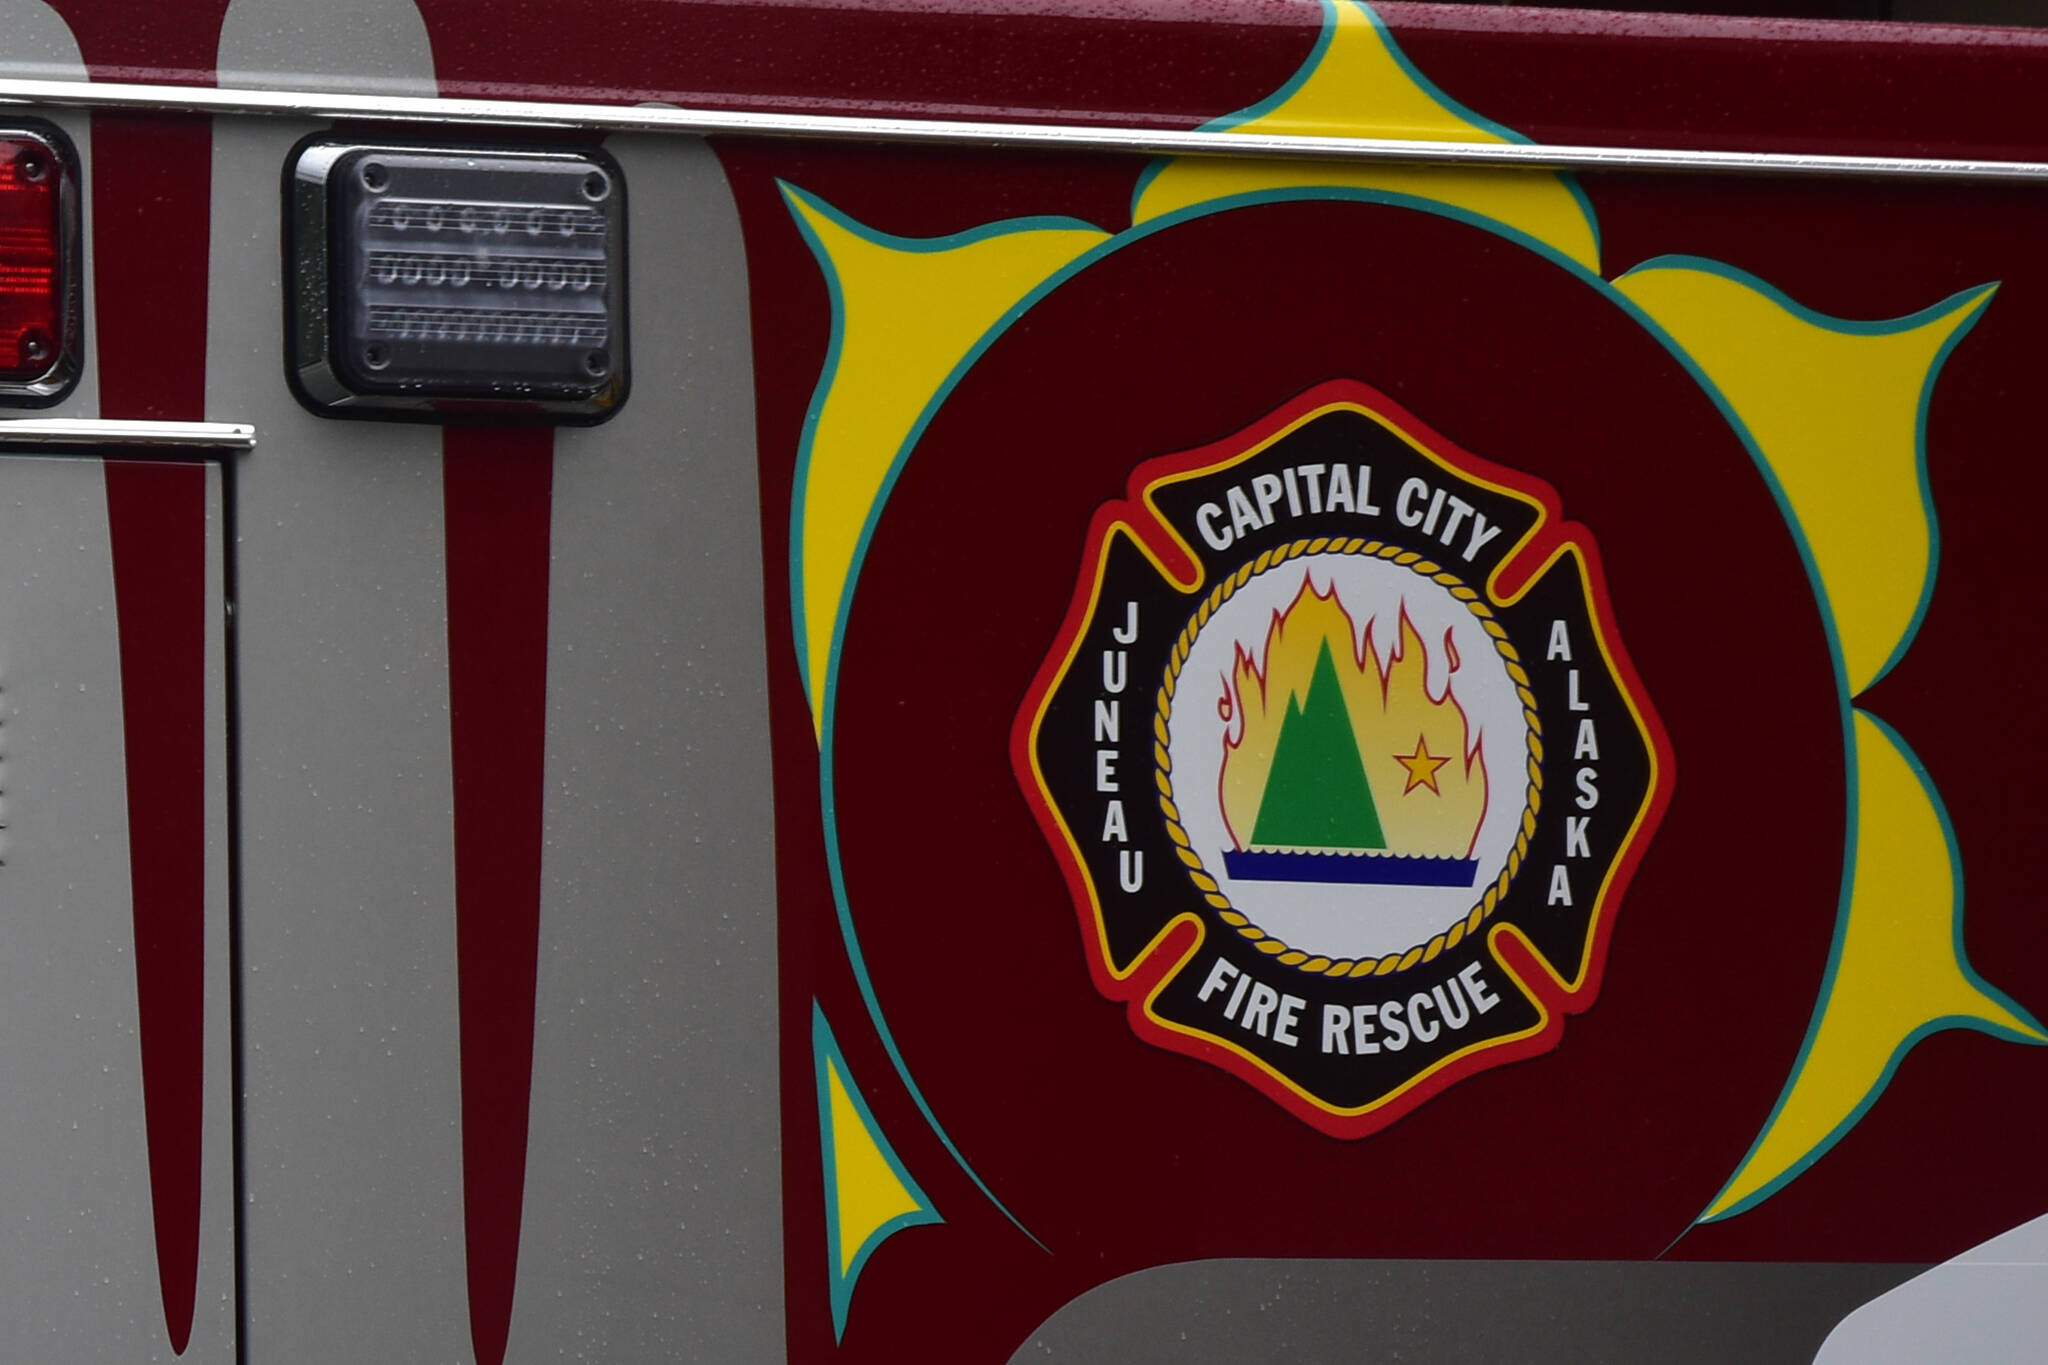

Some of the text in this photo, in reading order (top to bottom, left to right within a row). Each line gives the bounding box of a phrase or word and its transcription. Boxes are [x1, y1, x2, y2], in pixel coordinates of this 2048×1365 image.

[1197, 464, 1501, 561] CAPITAL CITY
[1095, 602, 1142, 892] JUNEAU
[1547, 620, 1598, 906] ALASKA
[1198, 957, 1500, 1054] FIRE RESCUE
